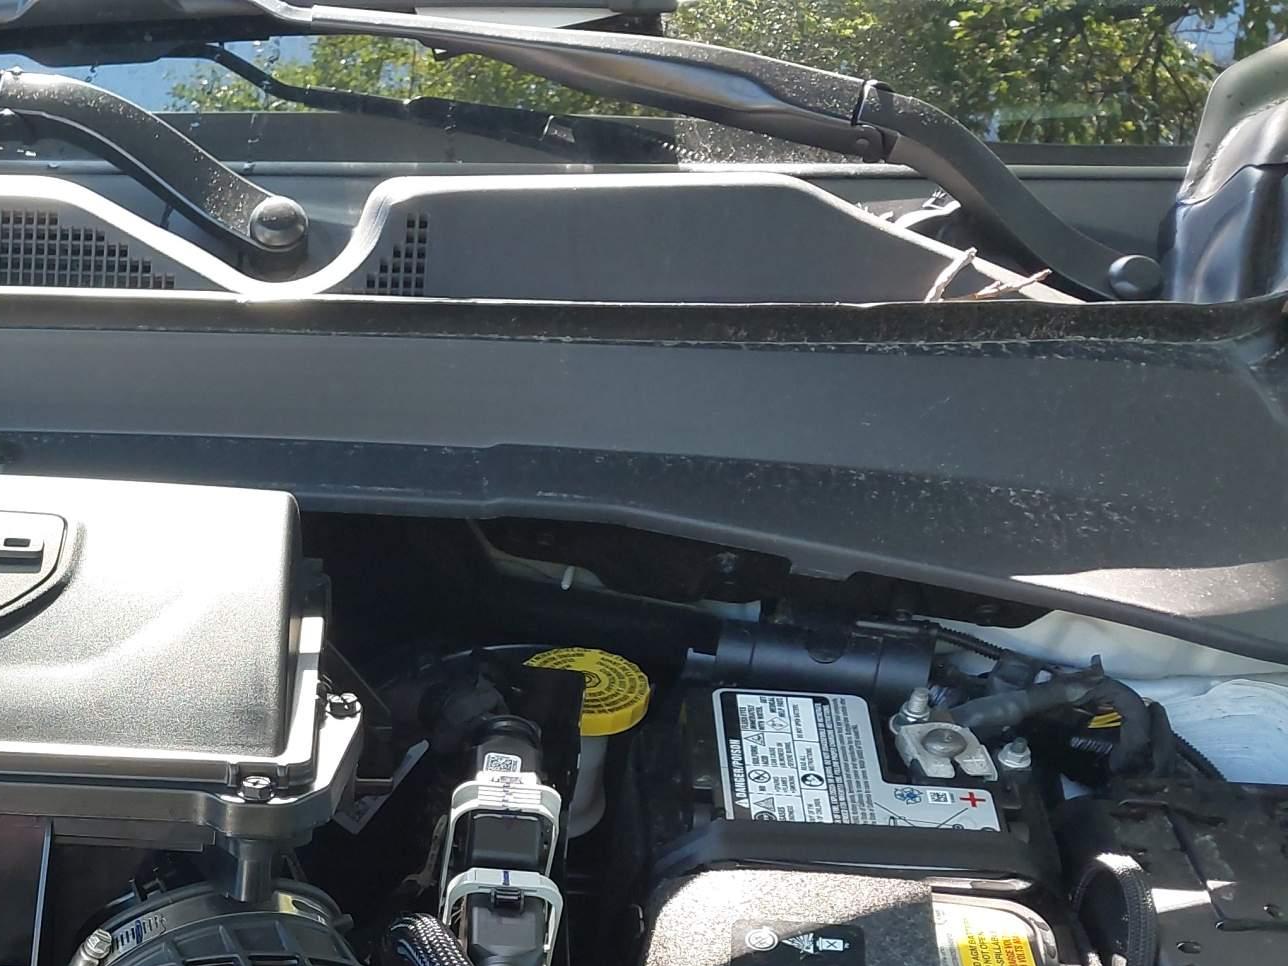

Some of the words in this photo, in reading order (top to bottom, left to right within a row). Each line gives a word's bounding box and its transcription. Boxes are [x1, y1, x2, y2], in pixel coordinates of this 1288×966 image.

[728, 739, 749, 798] DANGER/POISON
[969, 945, 981, 961] AGM
[981, 949, 992, 964] NOT
[1014, 945, 1026, 963] VOLTS
